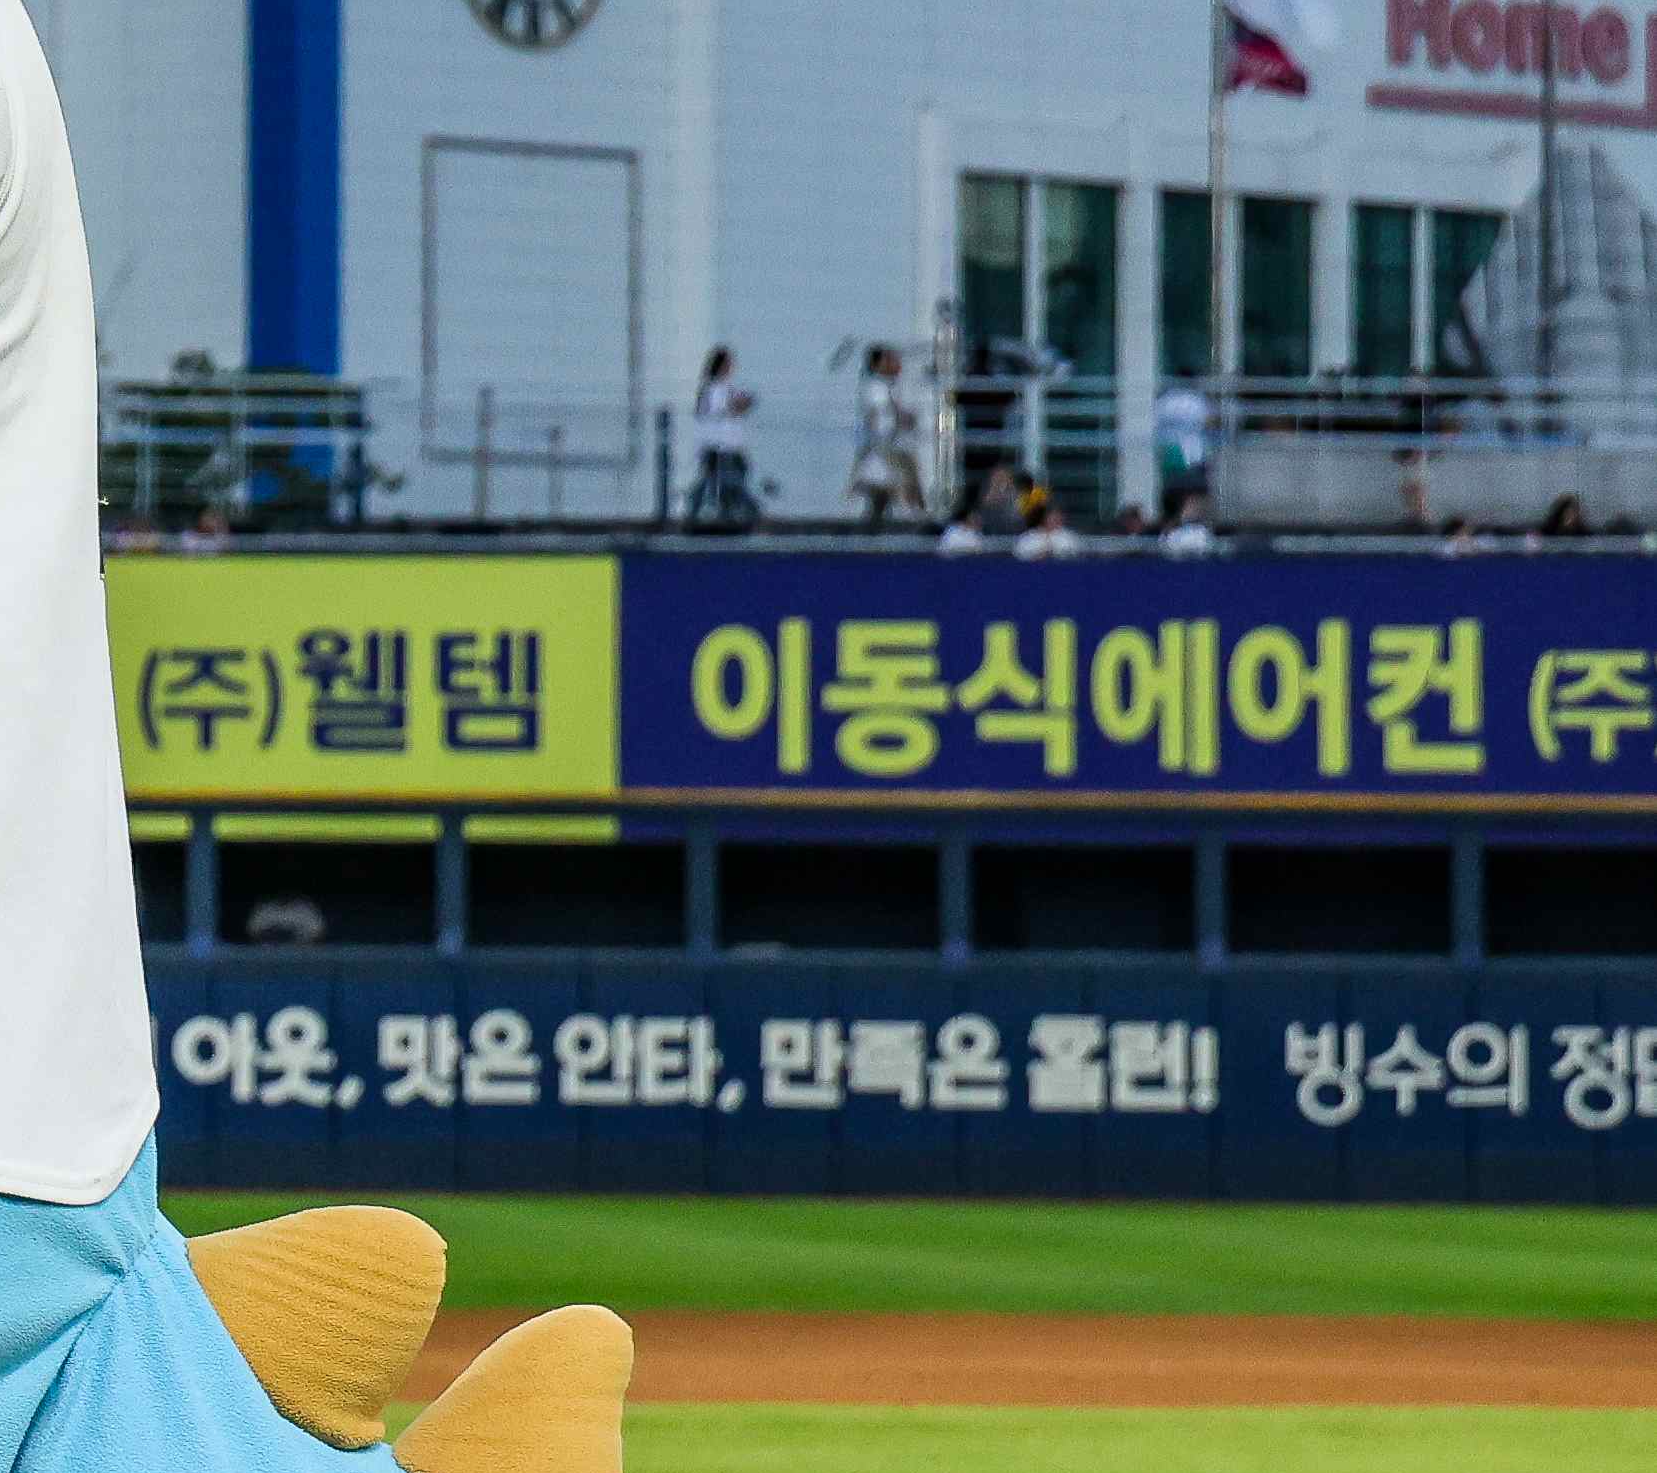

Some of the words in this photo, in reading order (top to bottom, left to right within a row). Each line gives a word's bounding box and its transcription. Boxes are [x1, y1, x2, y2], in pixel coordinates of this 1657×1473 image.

[137, 626, 543, 752] (주)웰템
[691, 616, 1486, 778] 이동식에어컨
[1530, 648, 1657, 762] (주
[171, 1005, 365, 1109] 아웃,
[377, 1009, 540, 1107] 맛은
[1026, 1013, 1220, 1113] 홈런!
[1284, 1021, 1530, 1127] 빙수의
